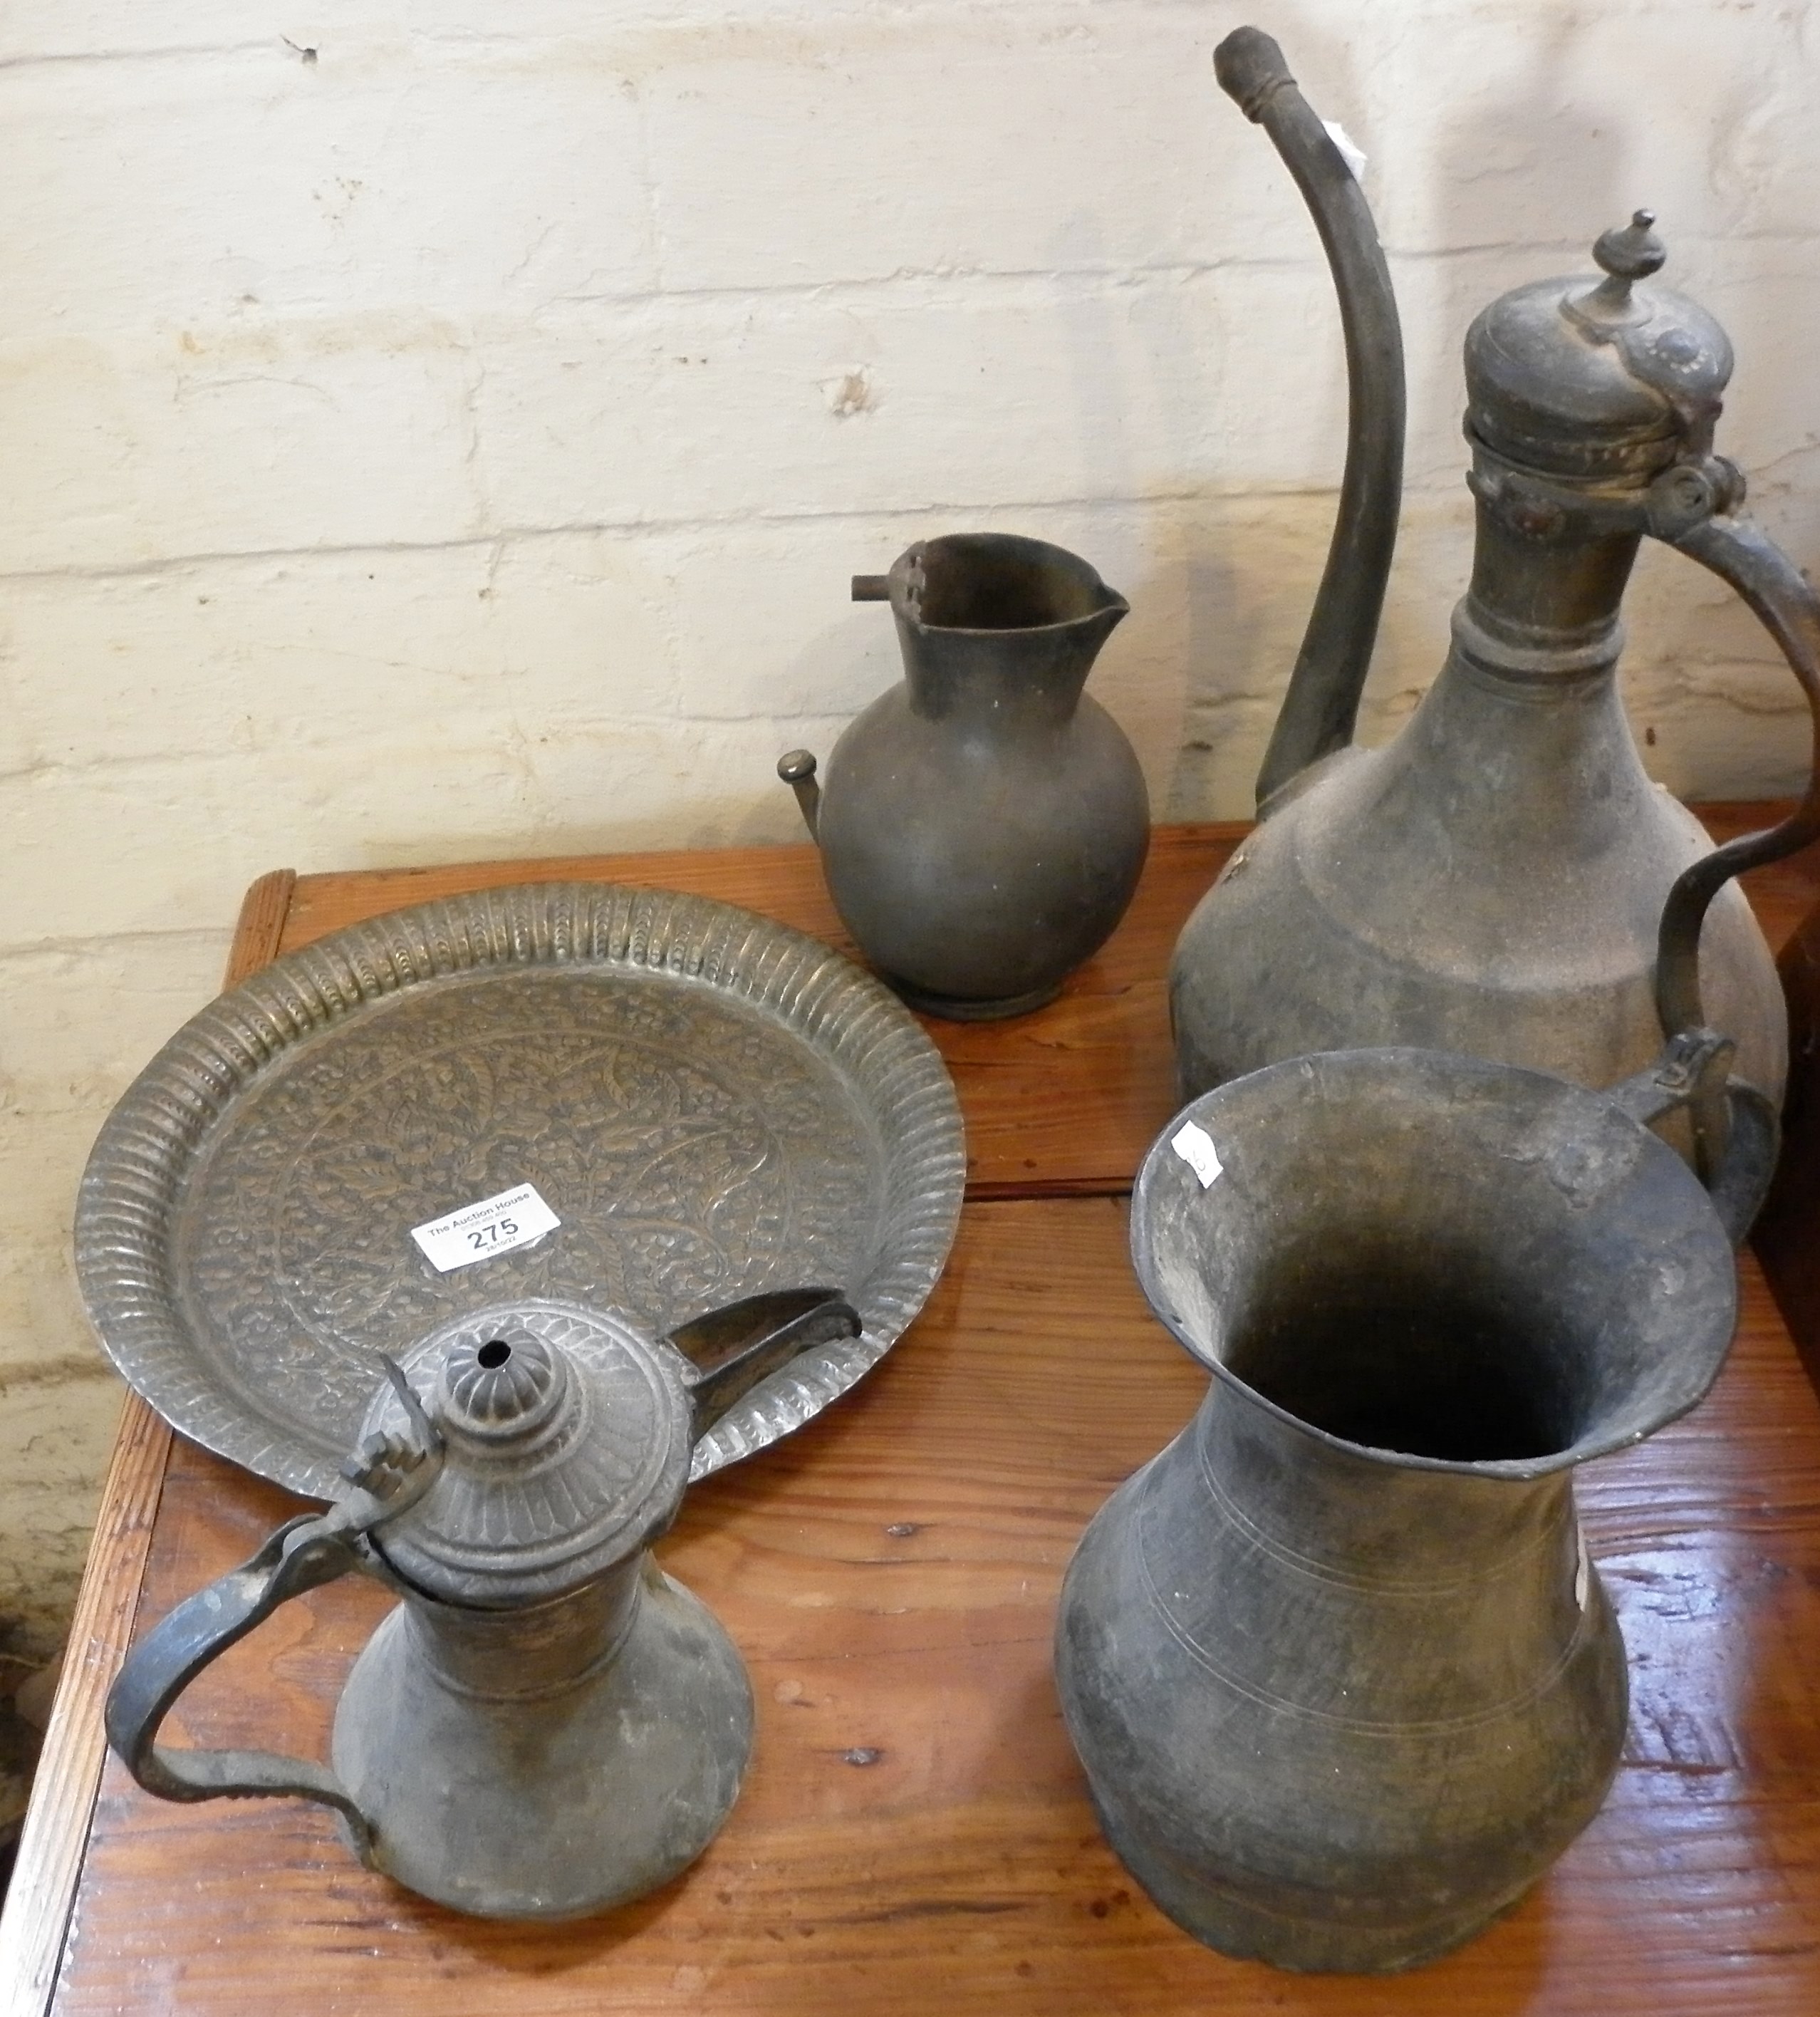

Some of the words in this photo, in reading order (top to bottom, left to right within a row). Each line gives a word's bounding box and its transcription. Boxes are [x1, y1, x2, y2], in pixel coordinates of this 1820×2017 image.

[427, 1225, 450, 1237] The
[453, 1208, 494, 1228] Auction
[495, 1192, 530, 1210] House
[467, 1218, 519, 1250] 275
